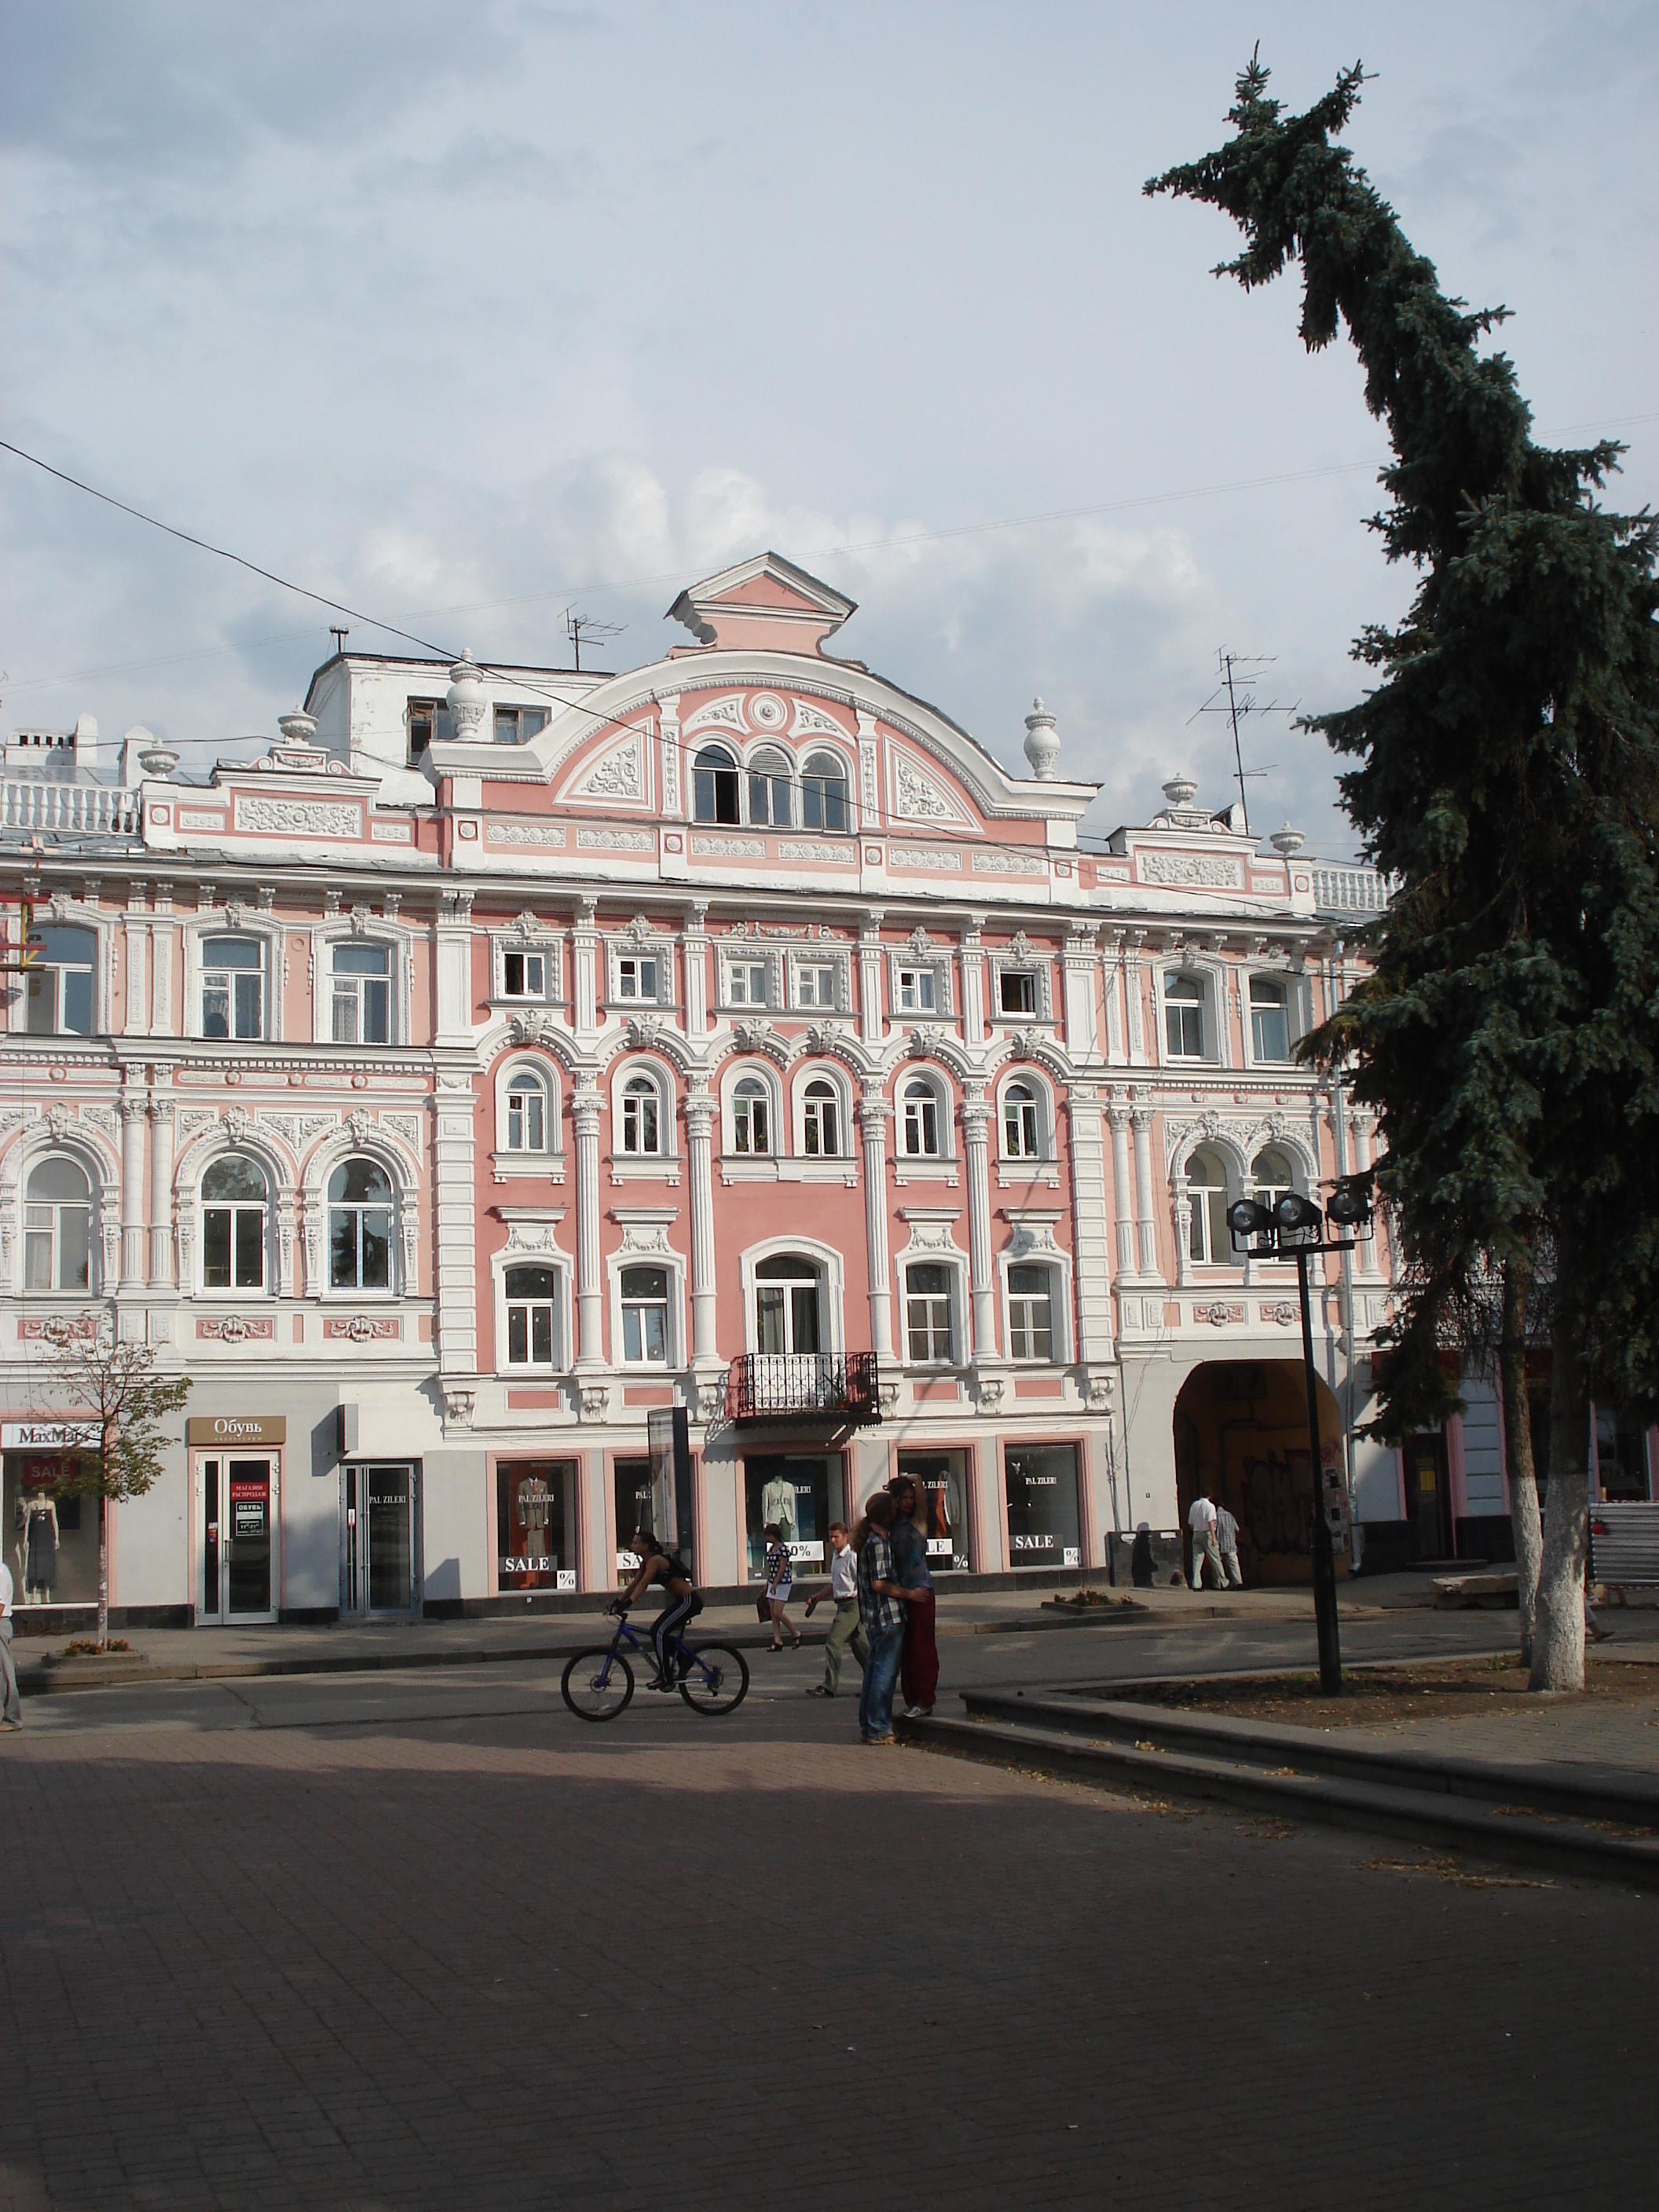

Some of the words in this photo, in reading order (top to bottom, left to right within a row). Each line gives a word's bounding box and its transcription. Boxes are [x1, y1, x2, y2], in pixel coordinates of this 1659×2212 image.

[214, 1418, 262, 1437] Обувь
[31, 1465, 71, 1478] SALE
[518, 1494, 531, 1503] PAL
[1015, 1535, 1054, 1549] SALE
[954, 1555, 969, 1569] %
[1066, 1550, 1079, 1562] %
[505, 1557, 550, 1572] SALE
[559, 1573, 574, 1586] %
